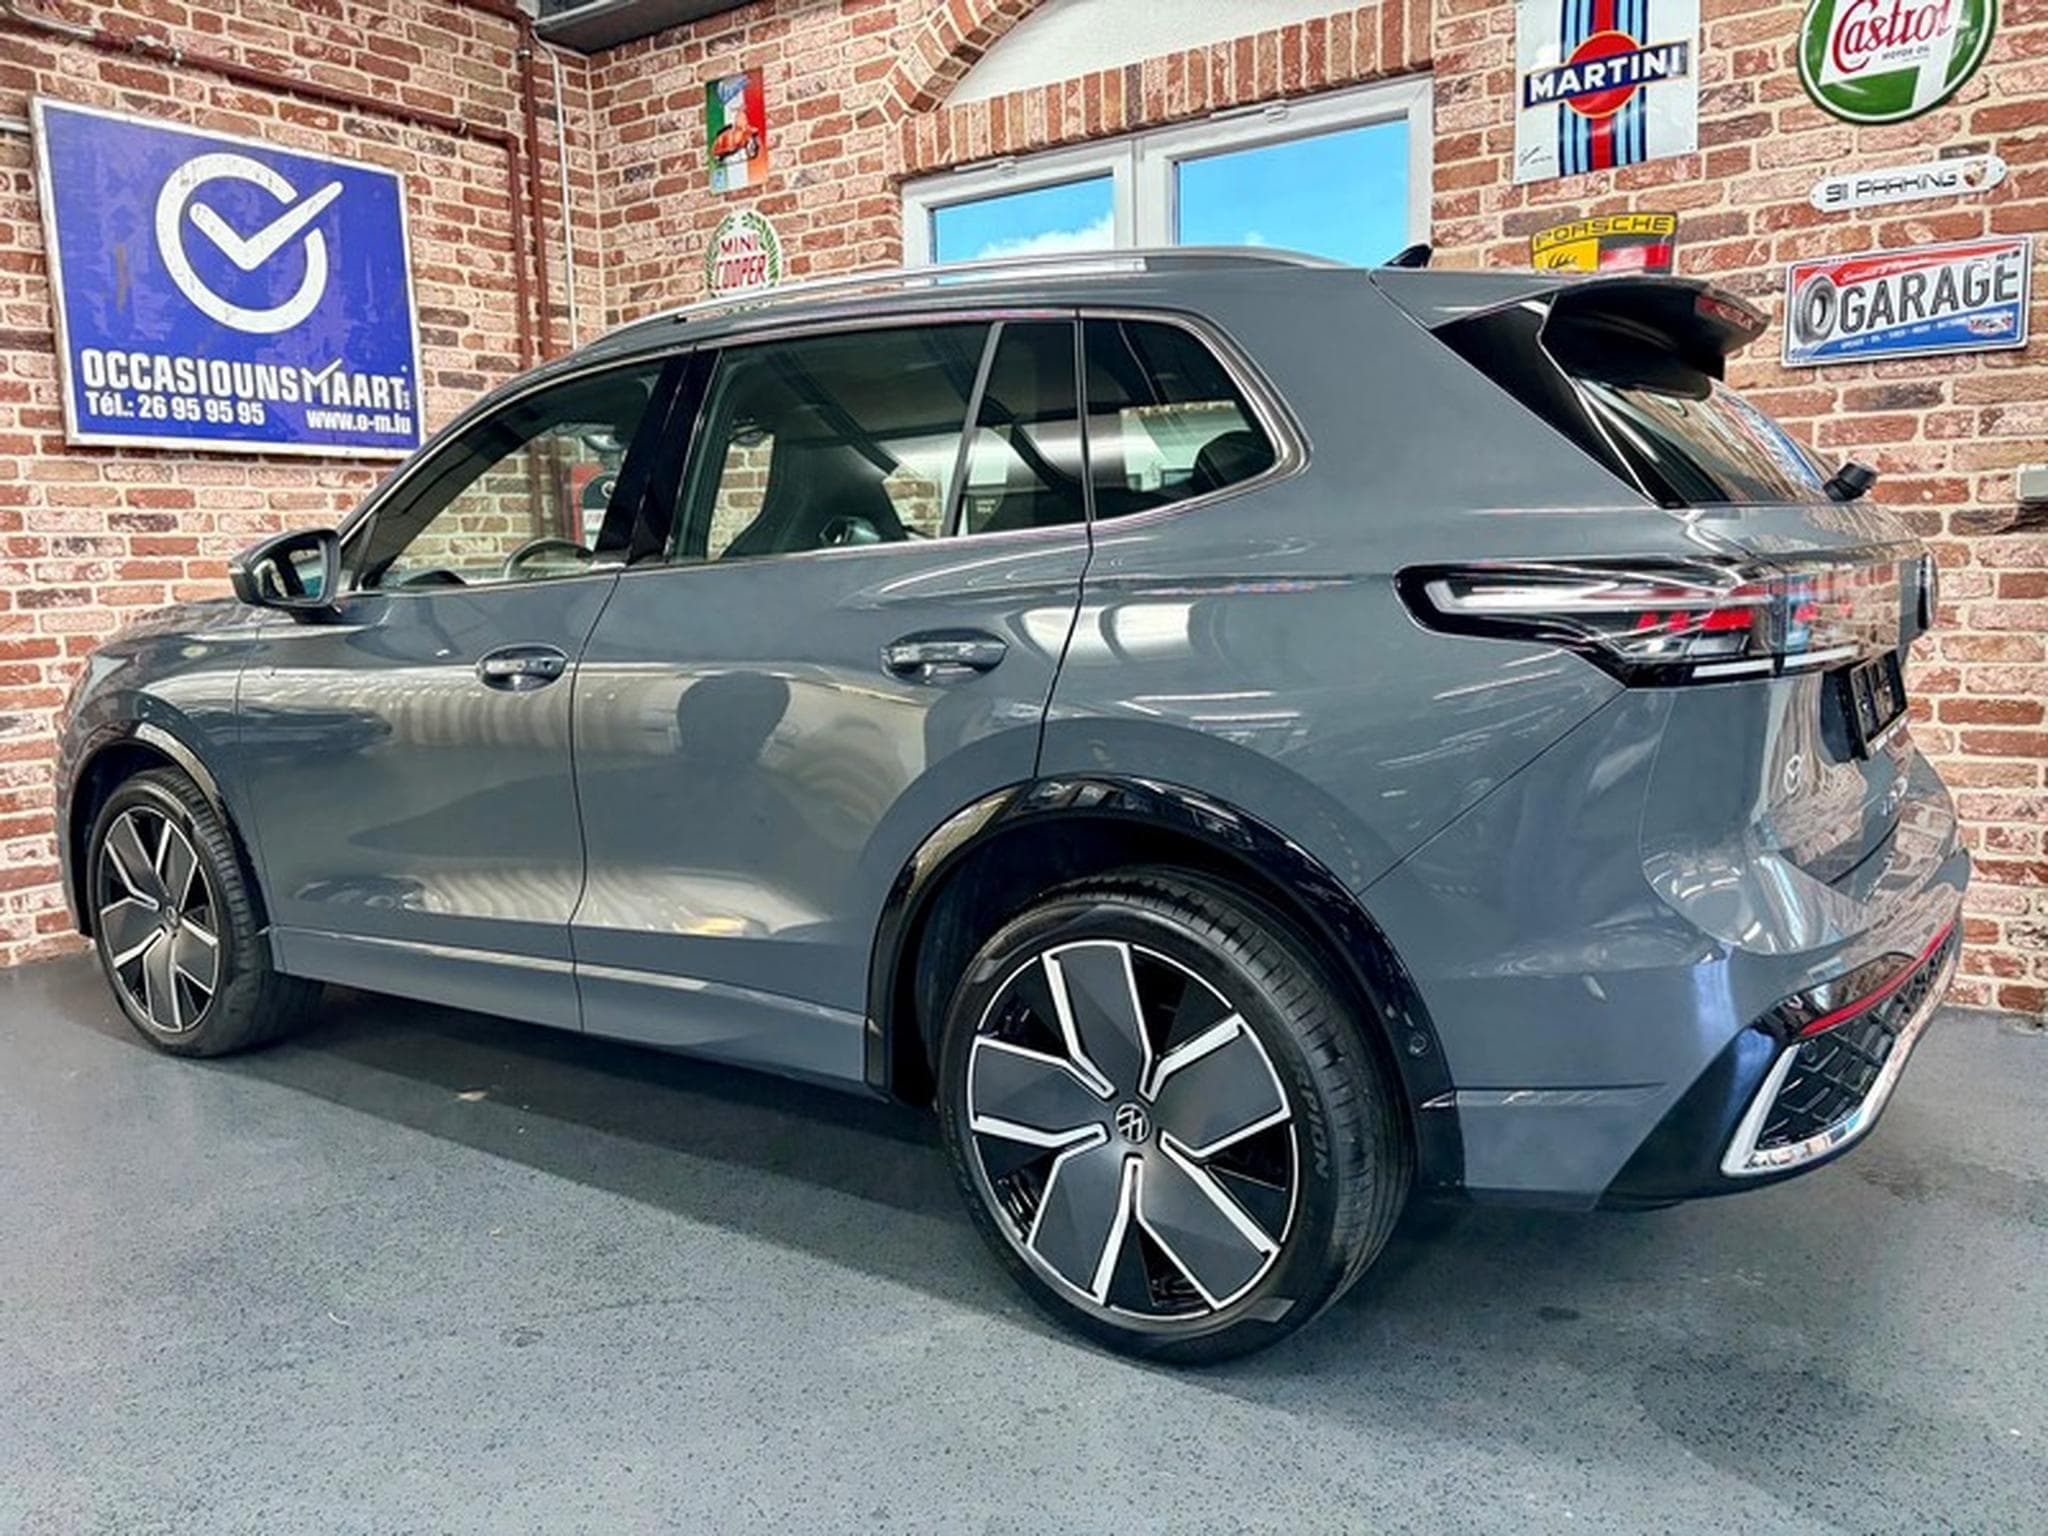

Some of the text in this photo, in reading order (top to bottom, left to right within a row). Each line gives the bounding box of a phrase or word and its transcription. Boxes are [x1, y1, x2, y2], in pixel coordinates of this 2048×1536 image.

[1832, 0, 1952, 74] Castrol
[1530, 46, 1680, 103] MARTINI
[1855, 172, 1958, 199] PARKING
[720, 235, 758, 255] MINI
[1536, 216, 1671, 248] PORSCHE
[716, 254, 767, 291] COOPER
[81, 349, 405, 411] OCCASIOUNSMAART
[138, 394, 168, 419] 26
[173, 397, 200, 421] 95
[206, 399, 232, 424] 95
[238, 402, 265, 426] 95
[306, 409, 412, 435] www.o-m.lu
